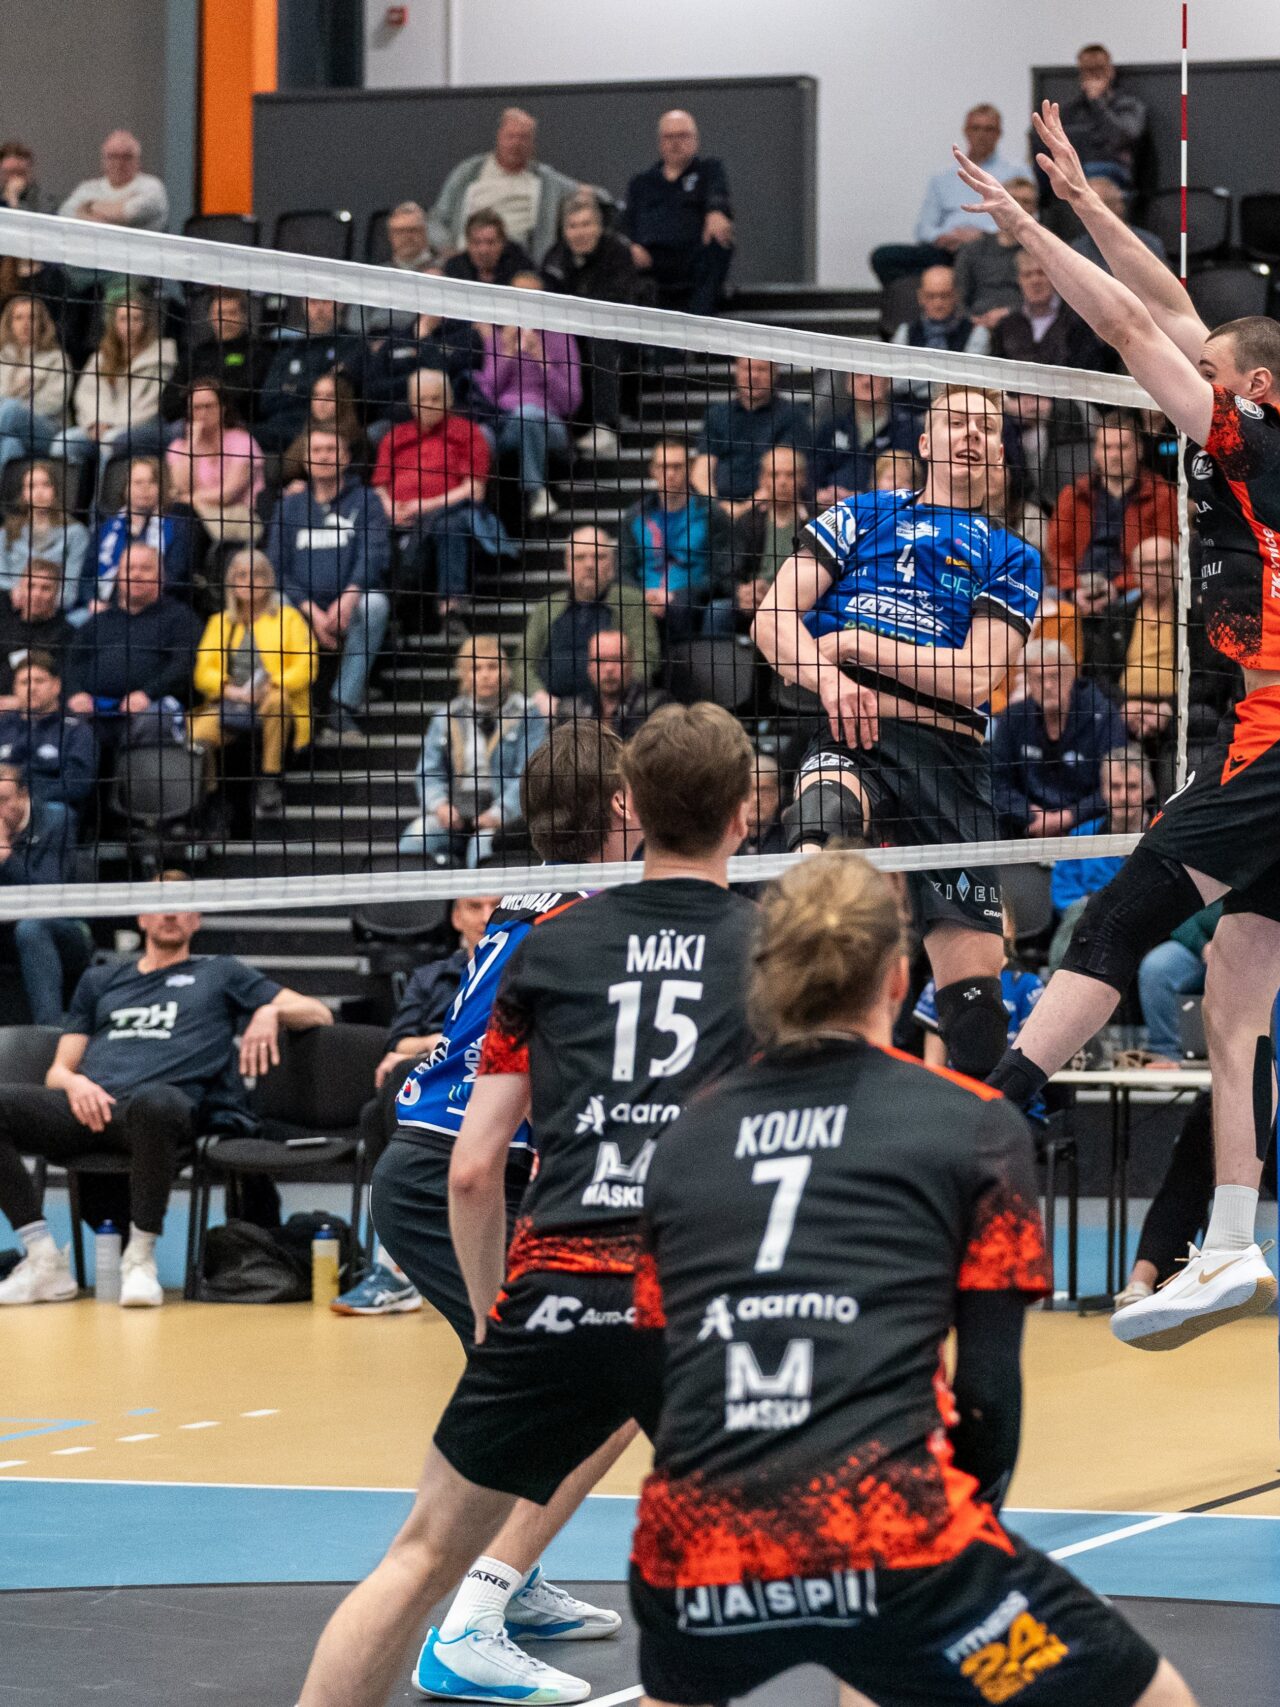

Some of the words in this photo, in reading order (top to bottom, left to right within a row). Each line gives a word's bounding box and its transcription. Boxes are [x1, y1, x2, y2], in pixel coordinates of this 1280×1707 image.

[895, 543, 914, 584] 4
[626, 929, 706, 973] MÄKI
[608, 980, 703, 1082] 15
[610, 1102, 681, 1124] aarn
[735, 1104, 848, 1159] KOUKI
[751, 1155, 812, 1273] 7
[524, 1294, 583, 1333] AC
[736, 1292, 859, 1324] aarnio
[466, 1569, 511, 1591] VANS
[961, 1610, 1048, 1687] 24
